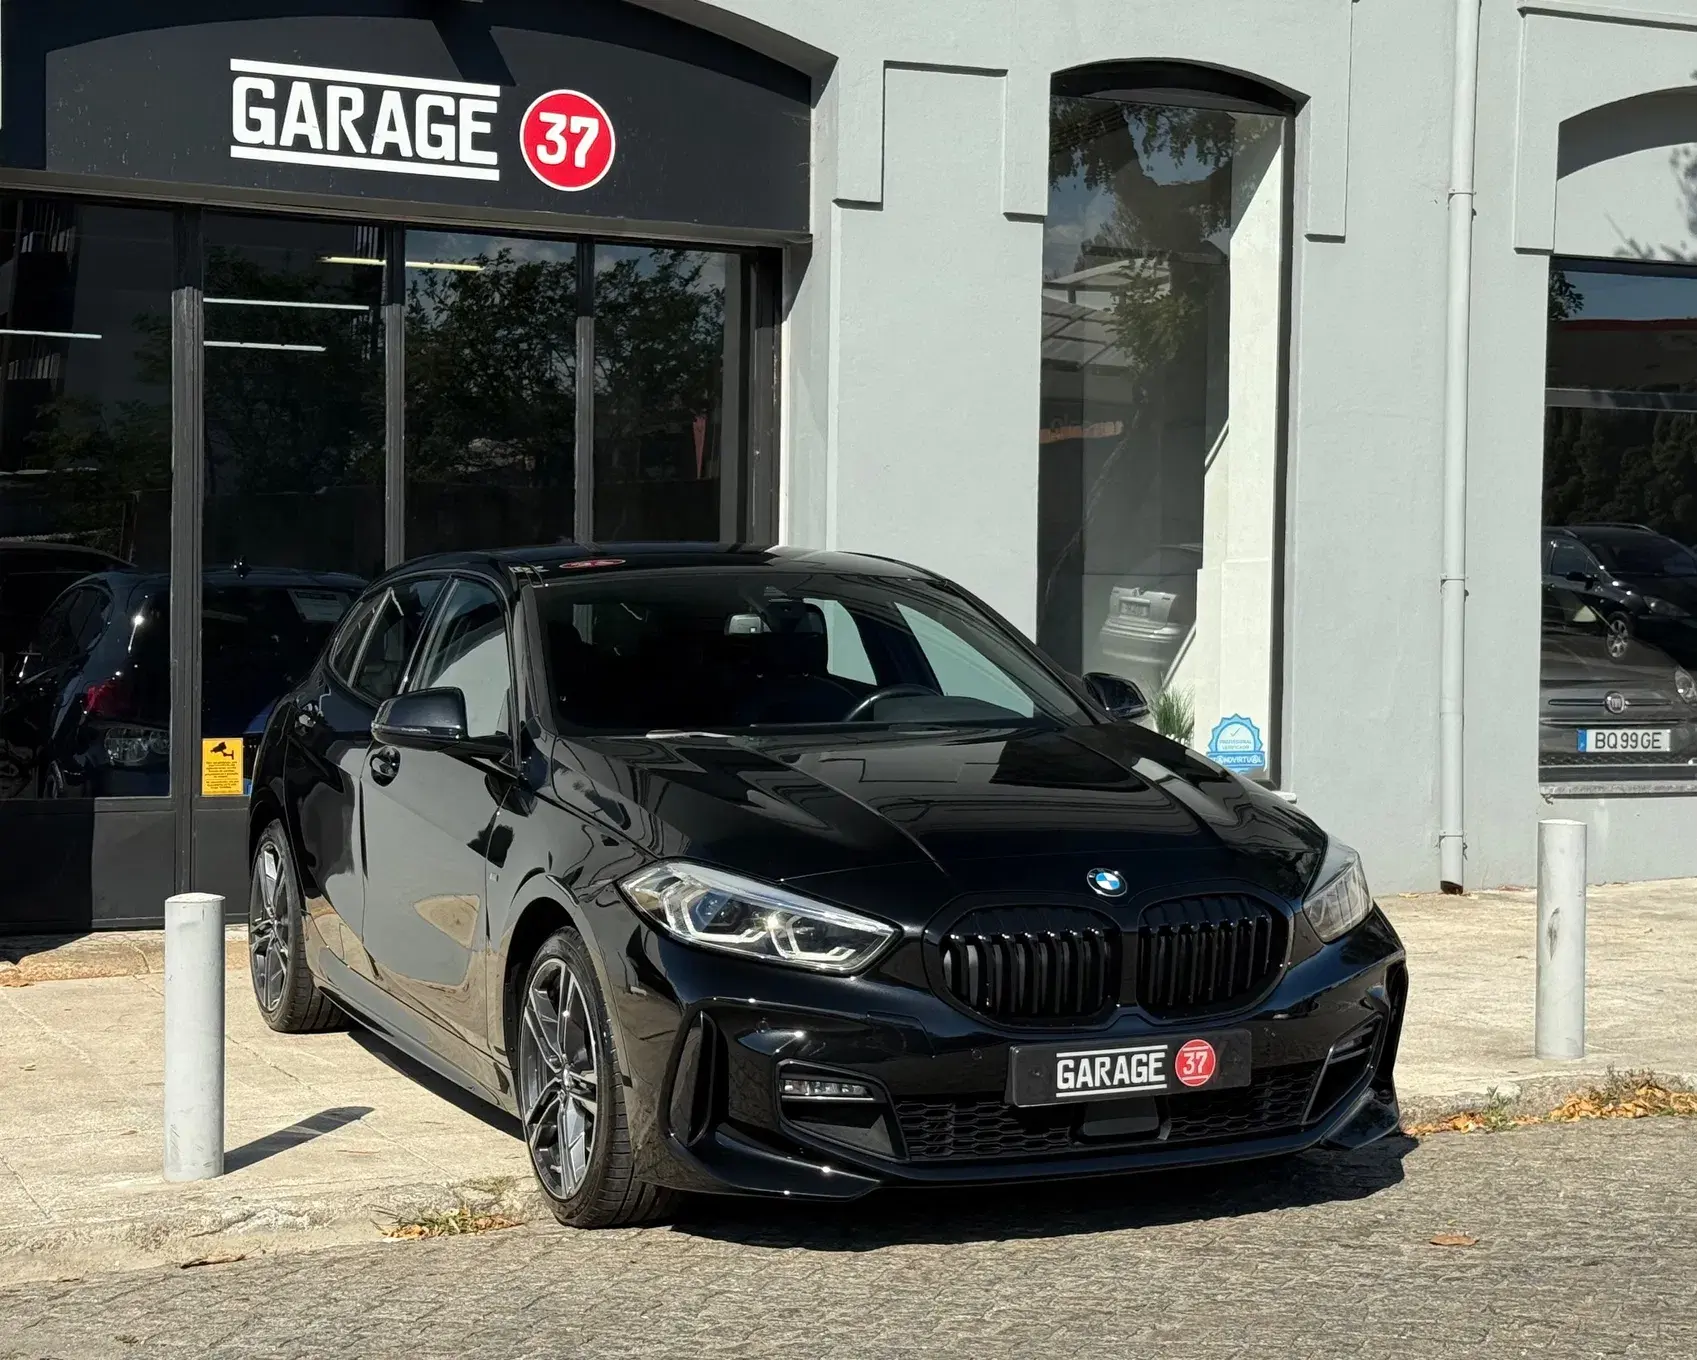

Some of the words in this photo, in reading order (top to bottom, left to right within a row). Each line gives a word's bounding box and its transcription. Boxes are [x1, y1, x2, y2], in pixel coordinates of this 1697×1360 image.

[232, 76, 498, 165] GARAGE
[536, 111, 600, 168] 37
[1056, 1052, 1166, 1089] GARAGE
[1182, 1051, 1208, 1075] 37
